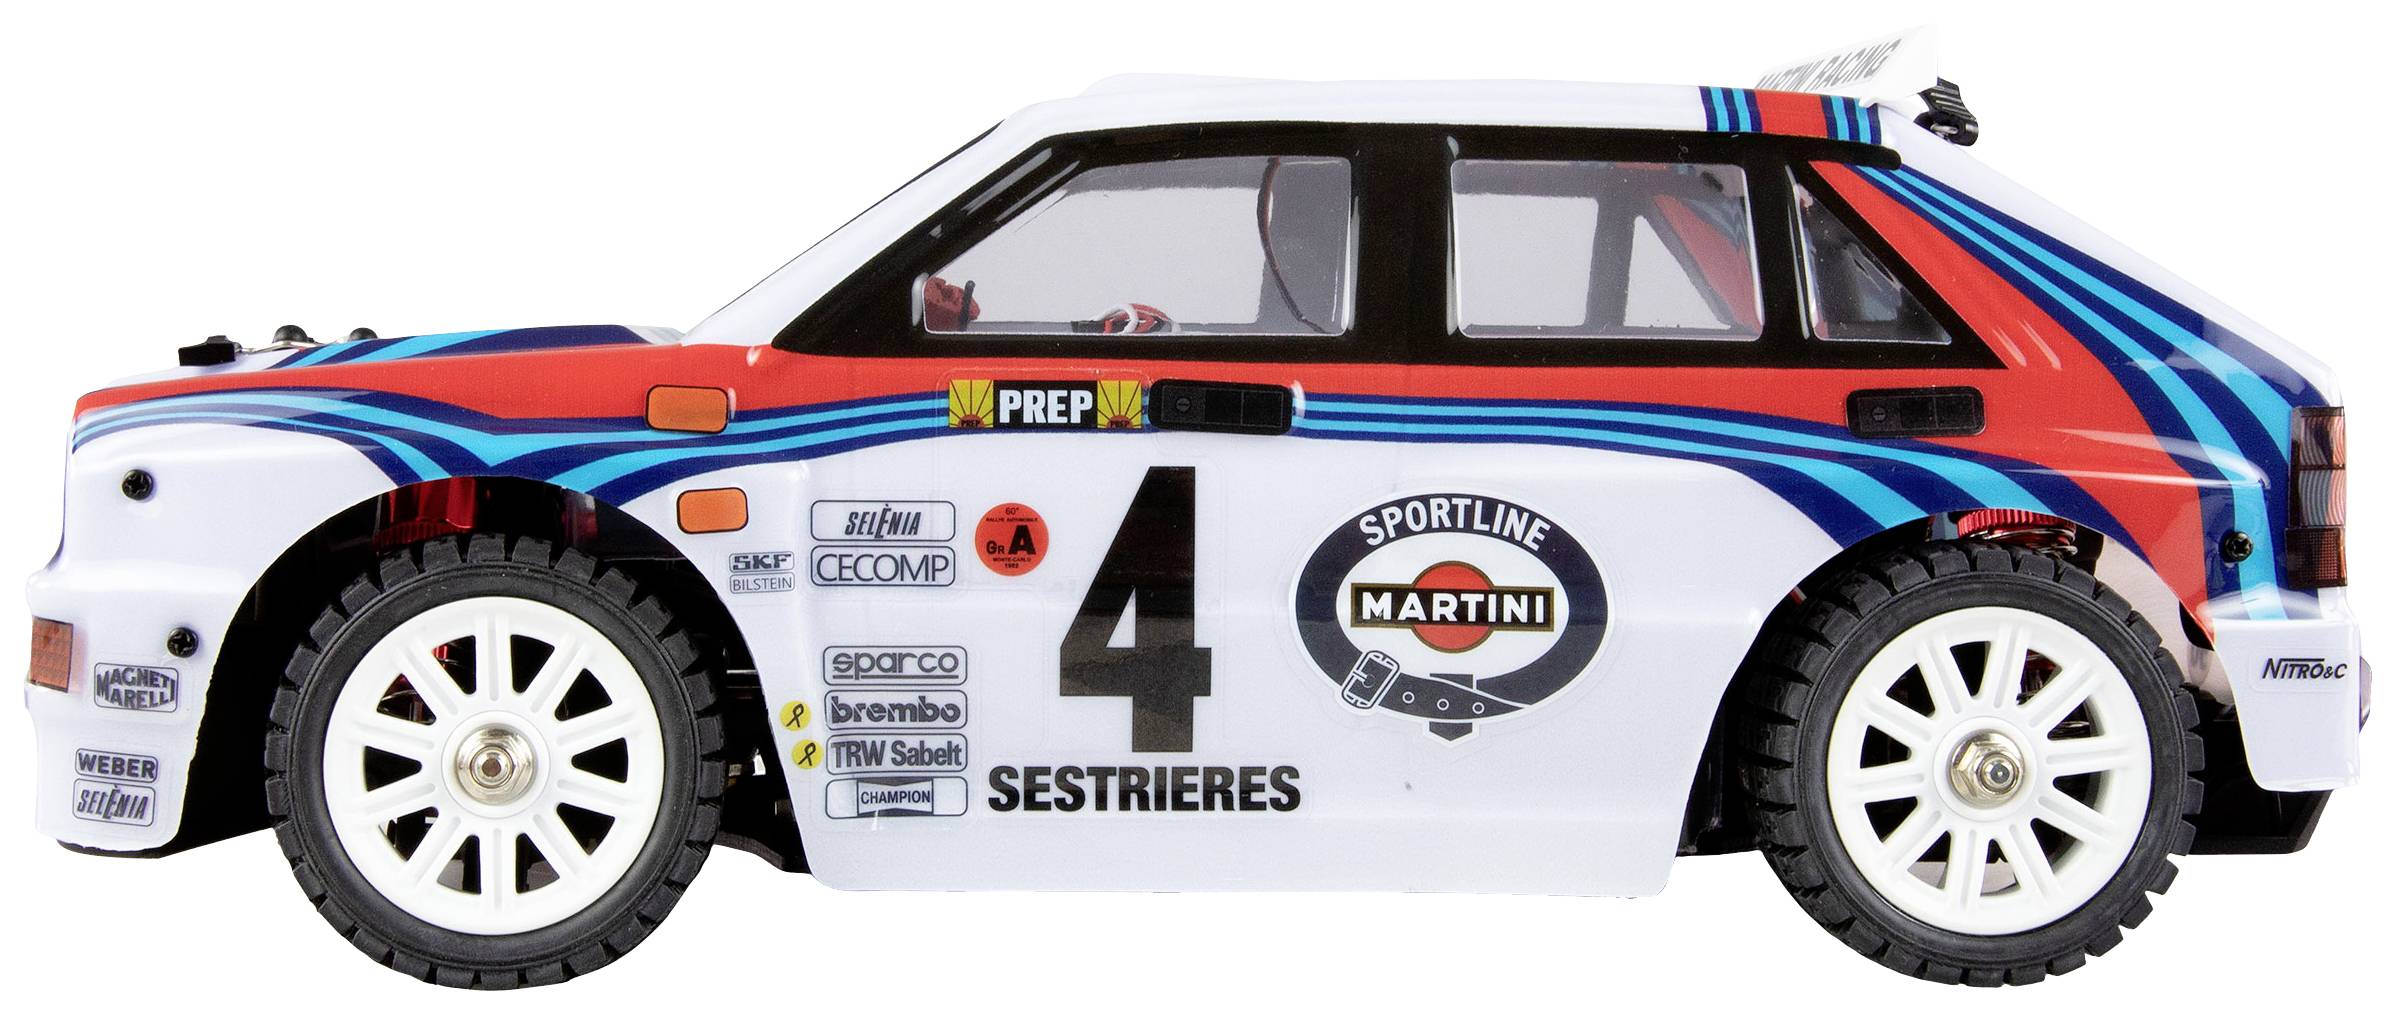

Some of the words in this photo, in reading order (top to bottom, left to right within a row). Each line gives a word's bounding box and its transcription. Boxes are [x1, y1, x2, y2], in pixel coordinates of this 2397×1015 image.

[1804, 39, 1902, 92] RACING
[999, 389, 1093, 424] PREP
[1359, 497, 1551, 551] SPORTLINE
[1008, 525, 1036, 555] A
[733, 554, 792, 571] SKF
[816, 553, 949, 582] CECOMP
[732, 577, 792, 591] BILSTEIN
[1060, 466, 1212, 752] 4
[1362, 592, 1544, 623] MARTINI
[832, 652, 960, 680] sparco
[97, 667, 175, 697] MAGNETI
[831, 696, 961, 723] brembo
[78, 752, 156, 778] WEBER
[831, 740, 886, 768] TRW
[890, 740, 962, 766] Sabelt
[860, 790, 931, 804] CHAMPION
[988, 766, 1301, 812] SESTRIERES
